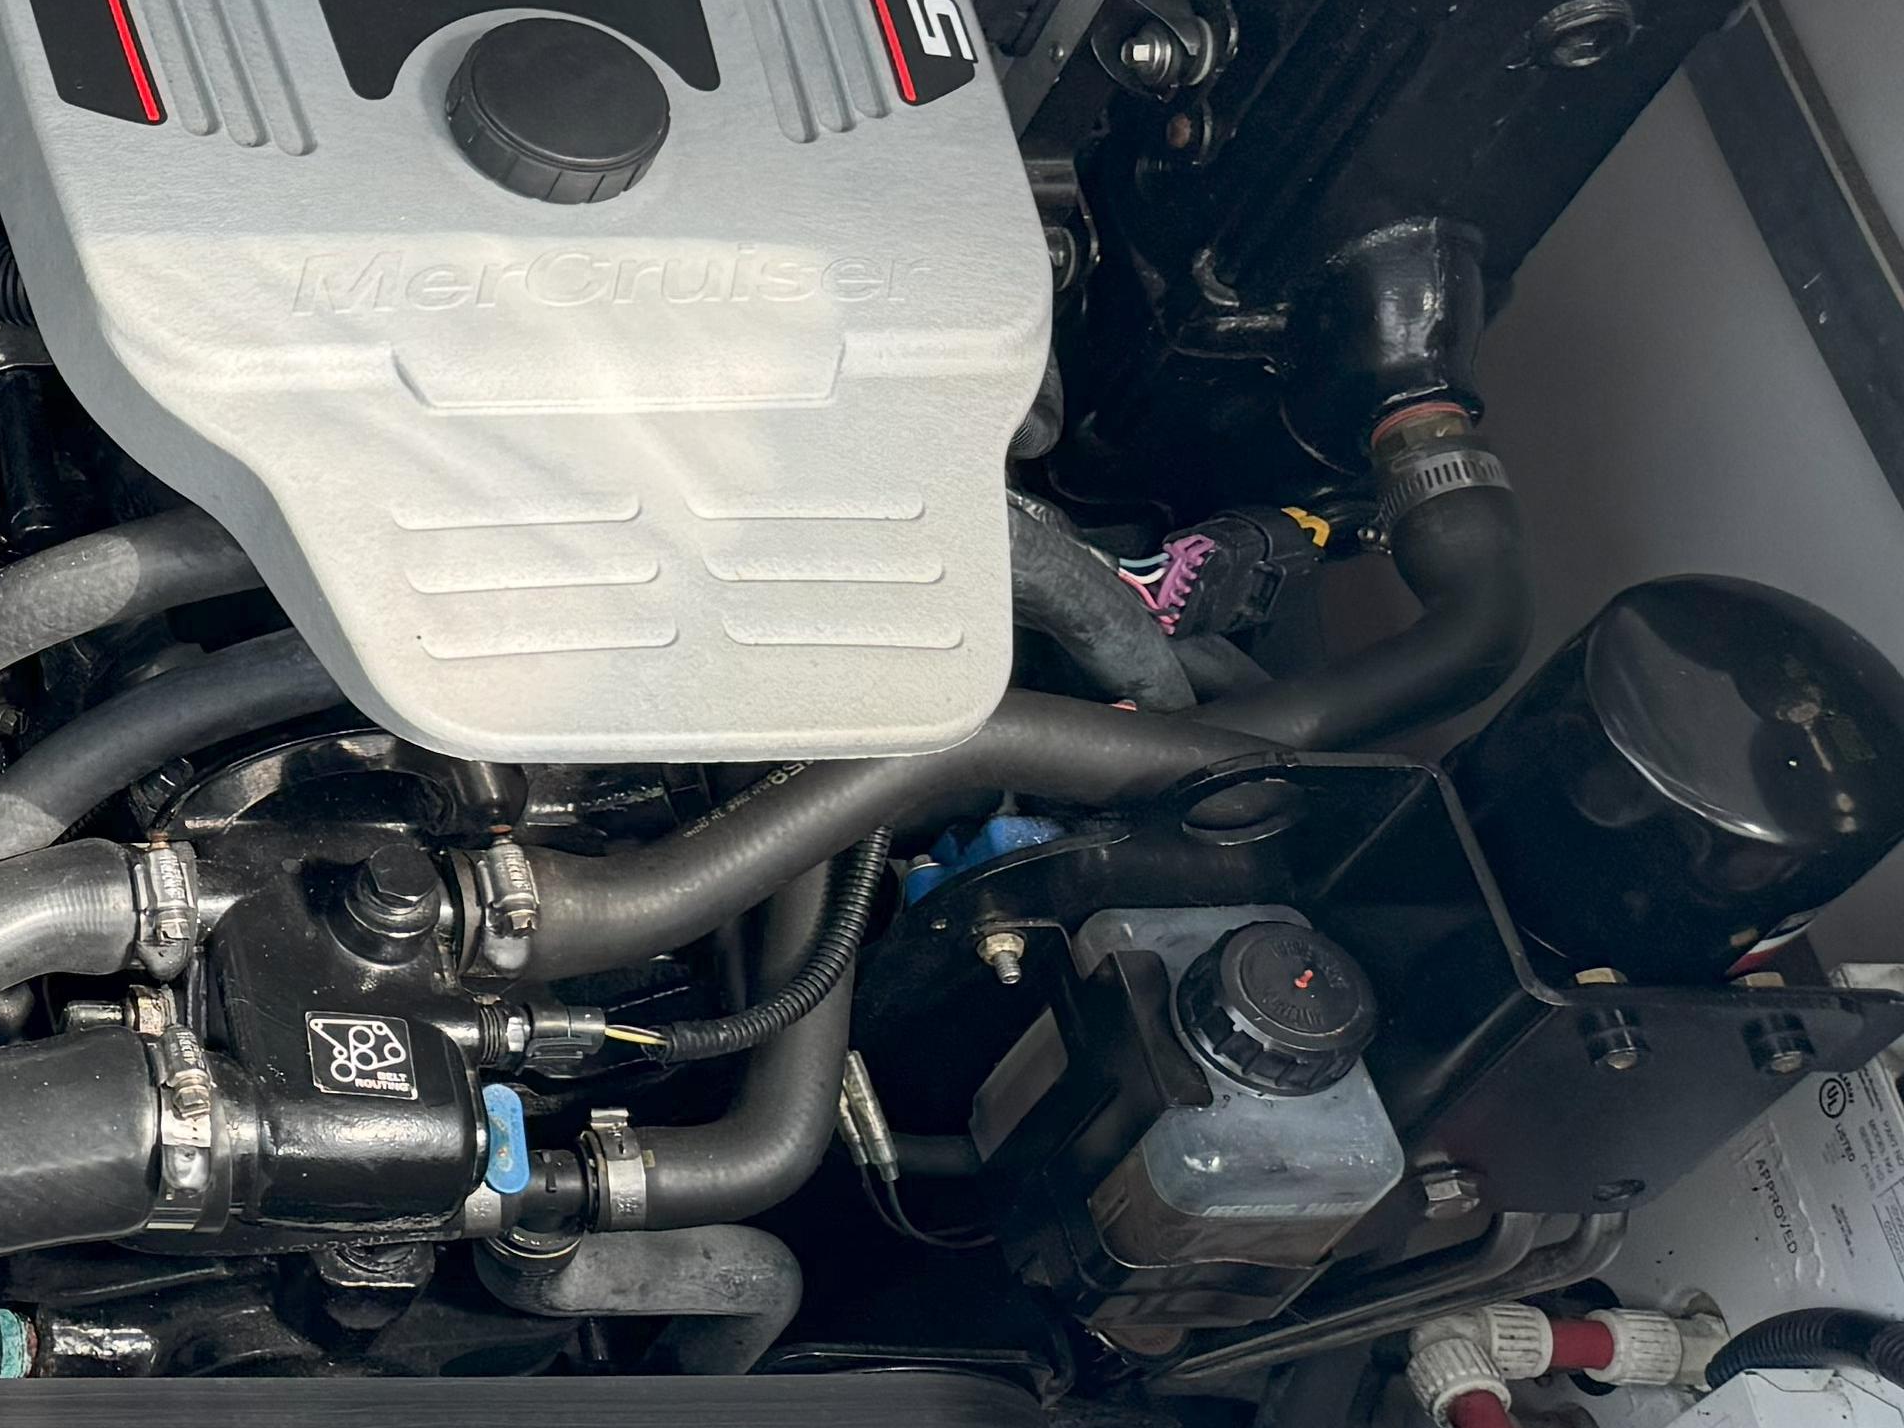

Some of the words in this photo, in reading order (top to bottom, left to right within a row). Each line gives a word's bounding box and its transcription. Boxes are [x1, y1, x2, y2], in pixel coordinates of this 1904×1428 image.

[291, 239, 939, 320] MerCruiser
[354, 1078, 412, 1092] ROUTING
[376, 1071, 408, 1082] BELT
[1832, 1122, 1857, 1163] LISTED
[1753, 1157, 1799, 1256] APPROVED
